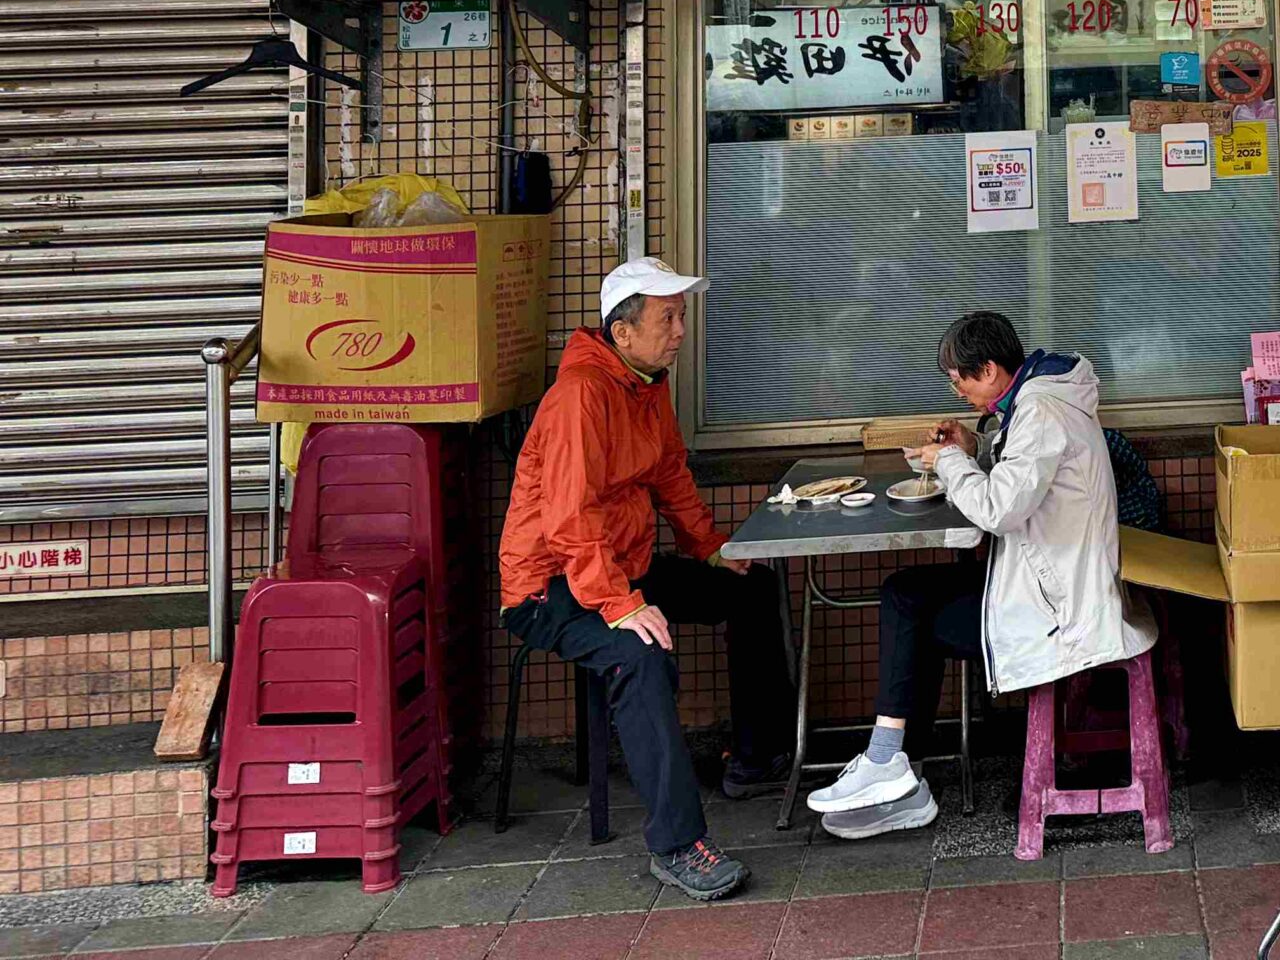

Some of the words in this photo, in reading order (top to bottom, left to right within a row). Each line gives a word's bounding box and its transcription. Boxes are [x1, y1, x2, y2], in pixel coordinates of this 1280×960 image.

[464, 12, 486, 21] 26巷
[793, 6, 841, 39] 110
[881, 3, 928, 37] 150
[975, 2, 1020, 37] 130
[440, 22, 452, 46] 1
[1236, 148, 1262, 158] 2025
[288, 290, 349, 307] 健康多一點
[331, 332, 383, 357] 780
[315, 408, 348, 419] made
[353, 408, 365, 419] in
[369, 407, 410, 420] taiwan
[0, 547, 82, 570] 小心階梯
